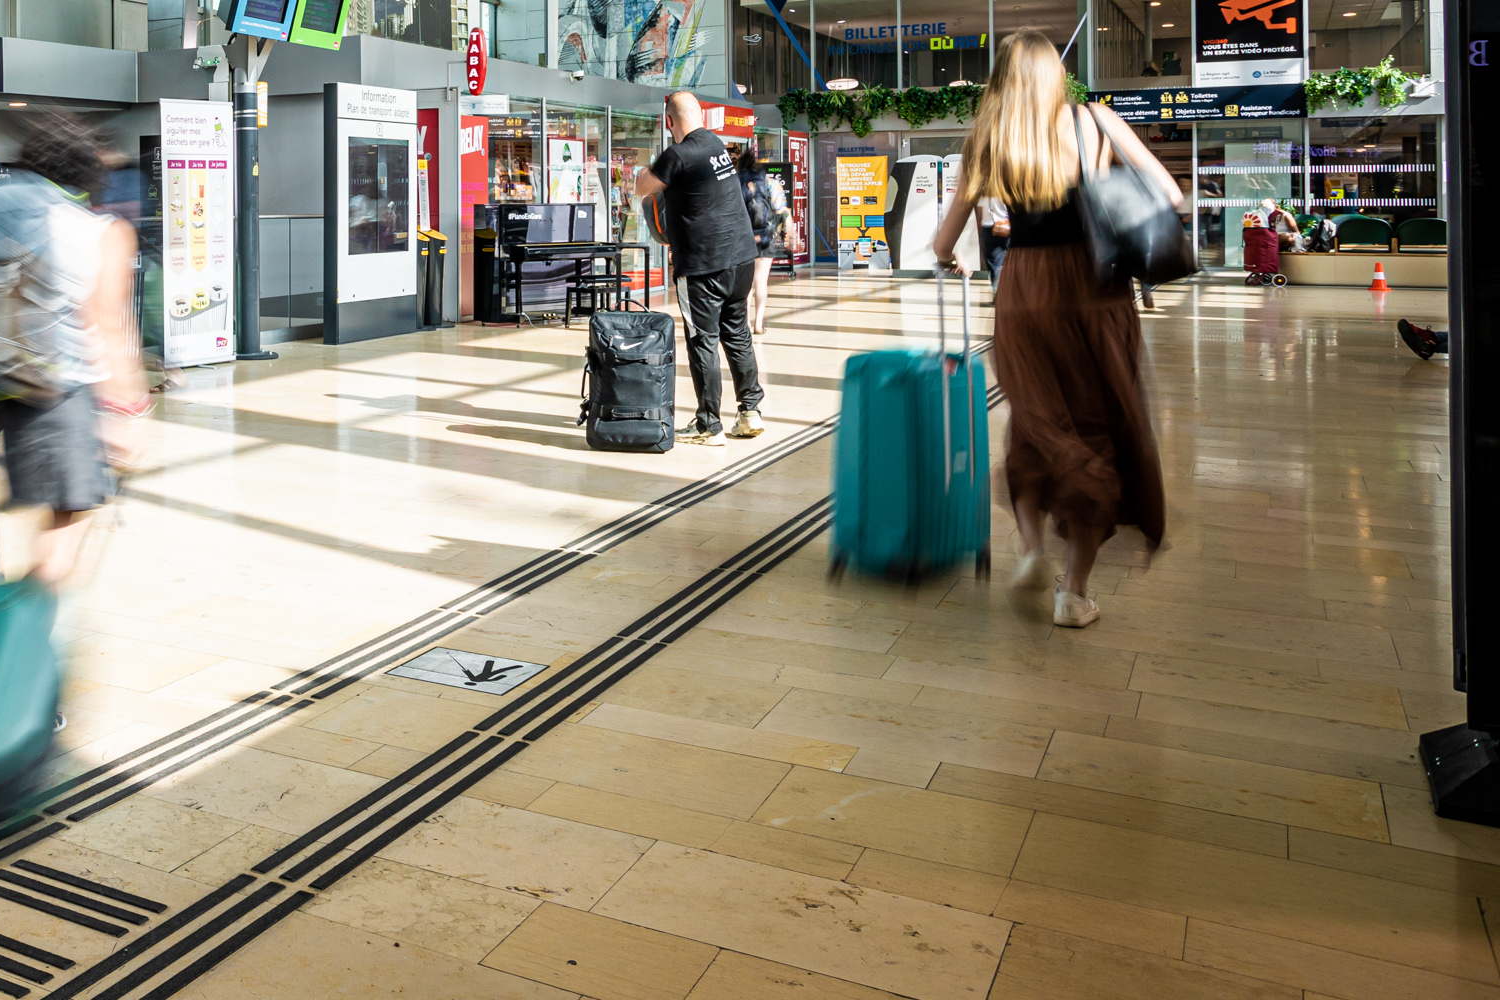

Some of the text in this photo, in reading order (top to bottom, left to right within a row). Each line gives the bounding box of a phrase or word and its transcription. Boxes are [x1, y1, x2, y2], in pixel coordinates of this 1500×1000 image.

[844, 22, 946, 40] BILLETTERIE
[469, 32, 480, 90] TABAC
[362, 90, 396, 104] Information
[347, 103, 410, 119] Plan de transport adapté
[166, 114, 207, 124] Comment bien
[167, 126, 188, 136] aiguiller
[167, 138, 188, 146] déchets
[198, 140, 210, 148] gare
[461, 125, 484, 155] RELAY
